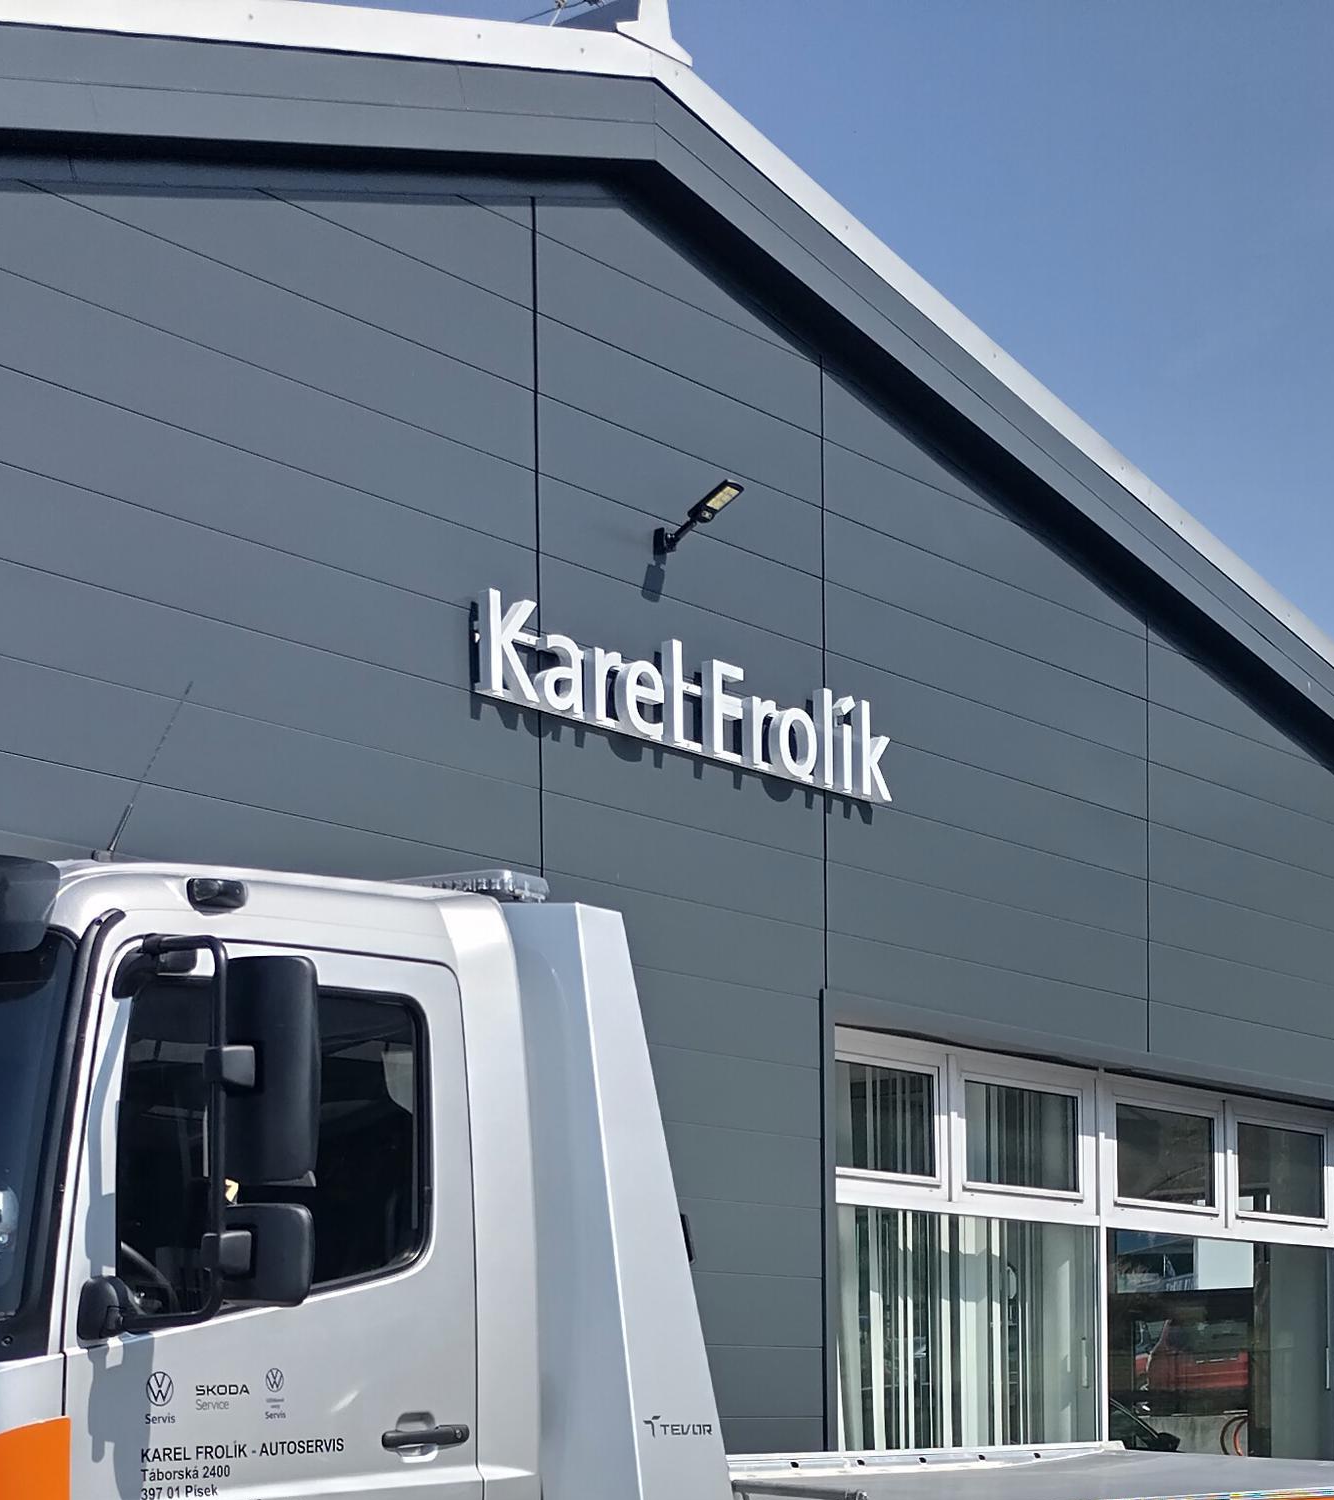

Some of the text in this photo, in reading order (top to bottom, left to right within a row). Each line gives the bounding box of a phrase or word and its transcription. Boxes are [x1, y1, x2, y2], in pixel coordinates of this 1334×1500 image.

[478, 588, 892, 802] Karel Frolík
[195, 1398, 229, 1411] Service
[145, 1413, 175, 1424] Servis
[659, 1423, 713, 1436] TEVOR
[141, 1446, 192, 1463] KAREL
[195, 1440, 247, 1460] FROLÍK
[259, 1438, 345, 1457] AUTOSERVIS
[140, 1464, 231, 1482] Táborská 2400
[141, 1487, 163, 1500] 397
[167, 1486, 180, 1499] 01
